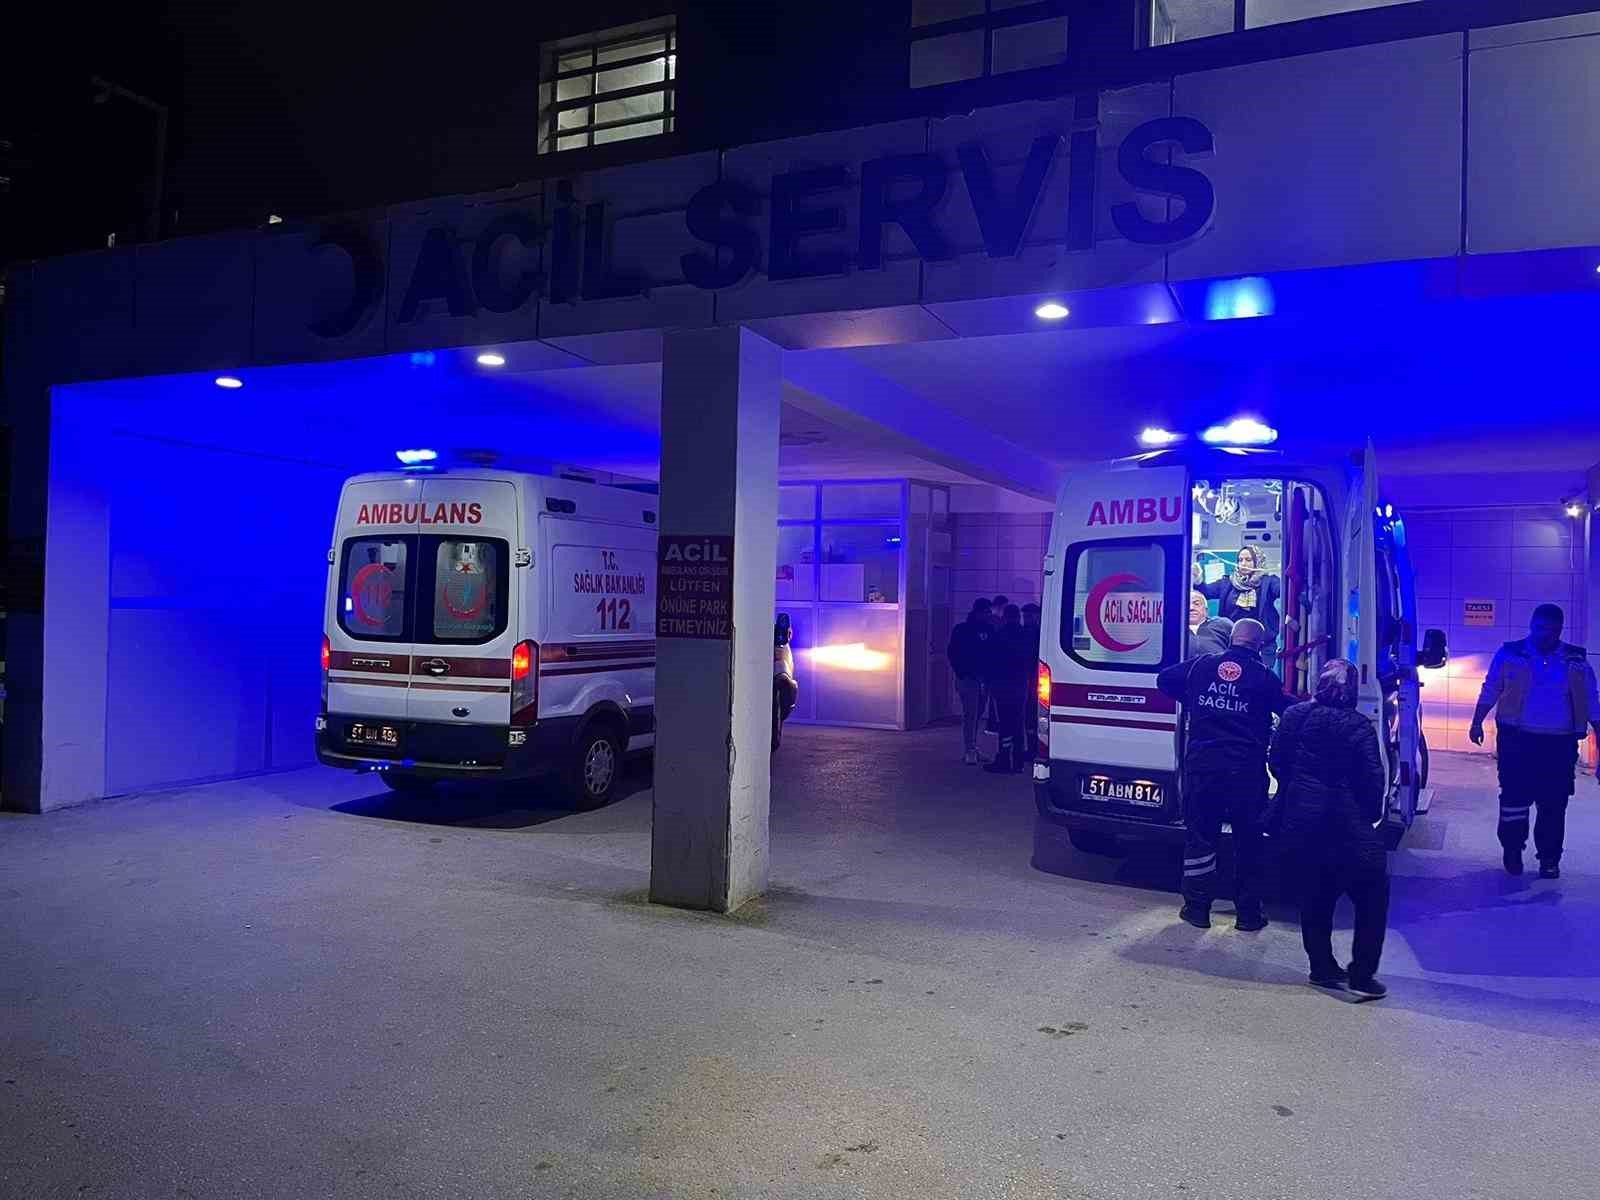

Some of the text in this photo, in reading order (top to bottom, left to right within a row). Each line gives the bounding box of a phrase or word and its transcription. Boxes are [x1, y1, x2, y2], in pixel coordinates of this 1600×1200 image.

[396, 94, 1217, 324] ACİL SERVİS
[357, 502, 482, 525] AMBULANS
[1087, 496, 1182, 527] AMBU
[601, 551, 619, 571] T.C.
[664, 538, 729, 562] ACİL
[574, 569, 646, 595] SAĞLIK BAKANLIĞI
[669, 577, 721, 593] LÜTFEN
[596, 597, 631, 630] 112
[660, 595, 729, 617] ÖNÜNE PARK
[1103, 597, 1164, 623] ACİL SAĞLIK
[658, 616, 729, 636] ETMEYİNİZ
[1207, 682, 1240, 697] ACİL
[1198, 695, 1249, 713] SAĞLIK
[1089, 780, 1161, 803] 51 ABN 814
